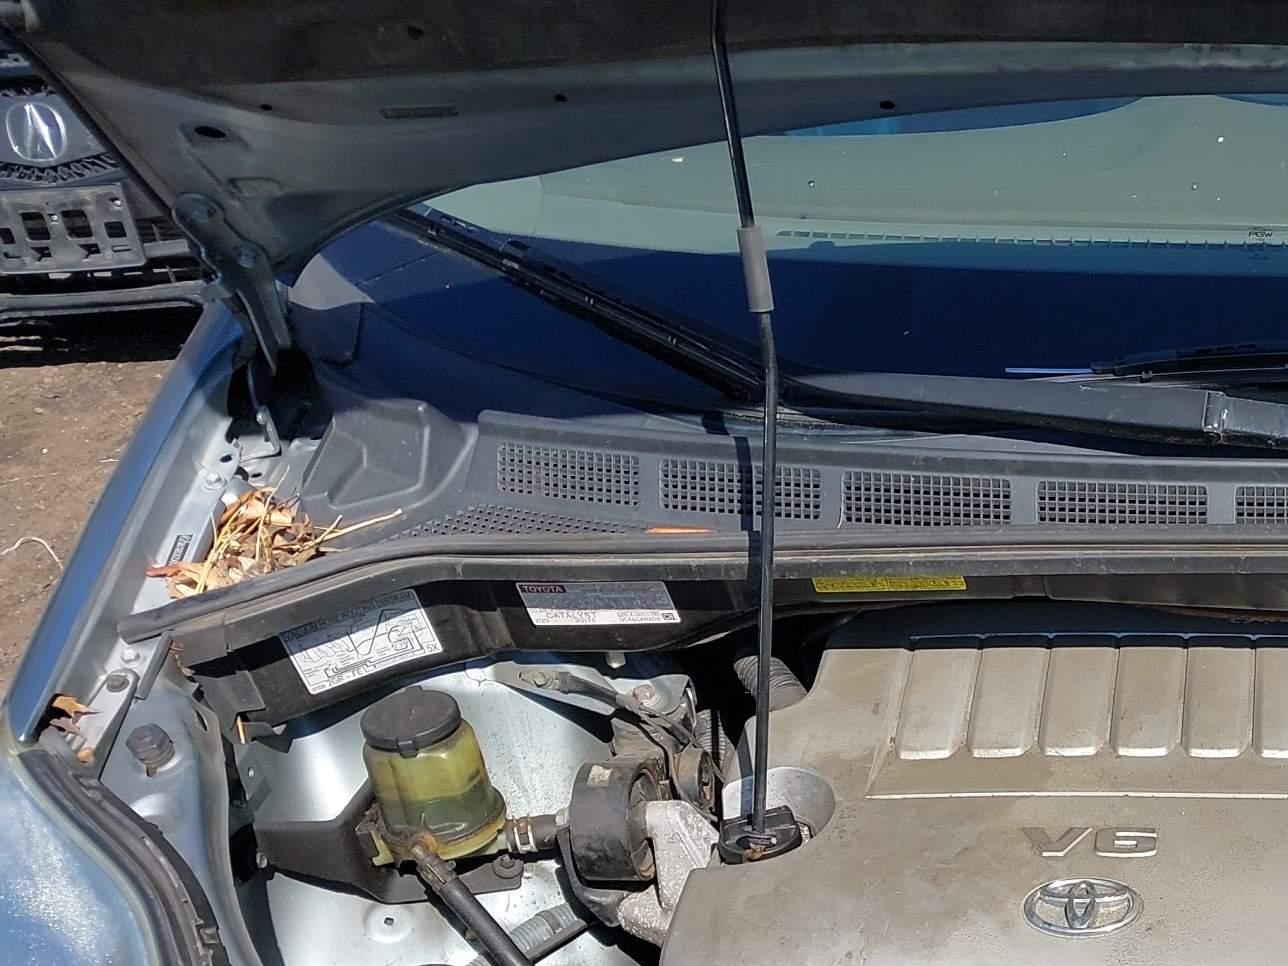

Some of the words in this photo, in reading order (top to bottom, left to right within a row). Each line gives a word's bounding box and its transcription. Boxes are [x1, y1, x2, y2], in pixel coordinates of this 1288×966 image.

[545, 611, 597, 620] CATALYST
[426, 643, 441, 654] 5X
[1023, 827, 1158, 858] V6
